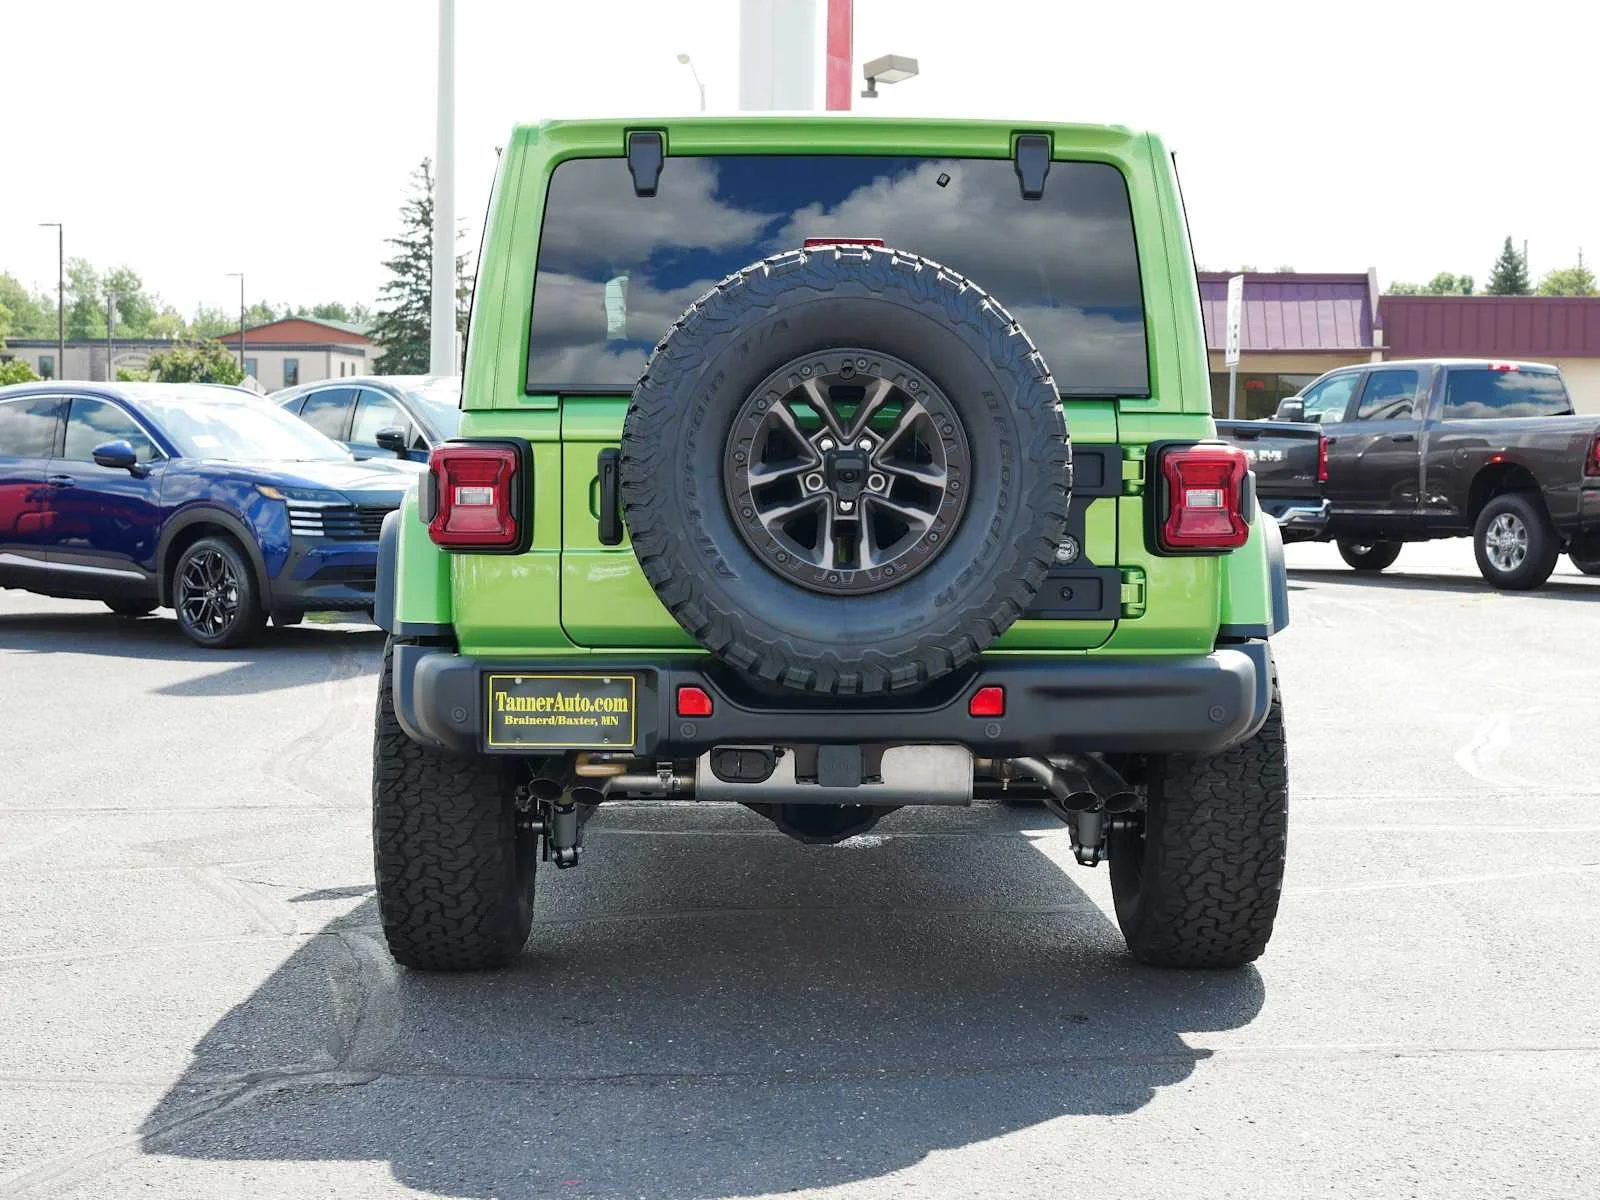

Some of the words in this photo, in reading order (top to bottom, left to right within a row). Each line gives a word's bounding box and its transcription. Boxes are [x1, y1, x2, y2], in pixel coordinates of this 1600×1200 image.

[495, 691, 628, 712] TannerAuto.com
[504, 716, 598, 726] Brainerd/Baxter,
[601, 716, 619, 726] MN
